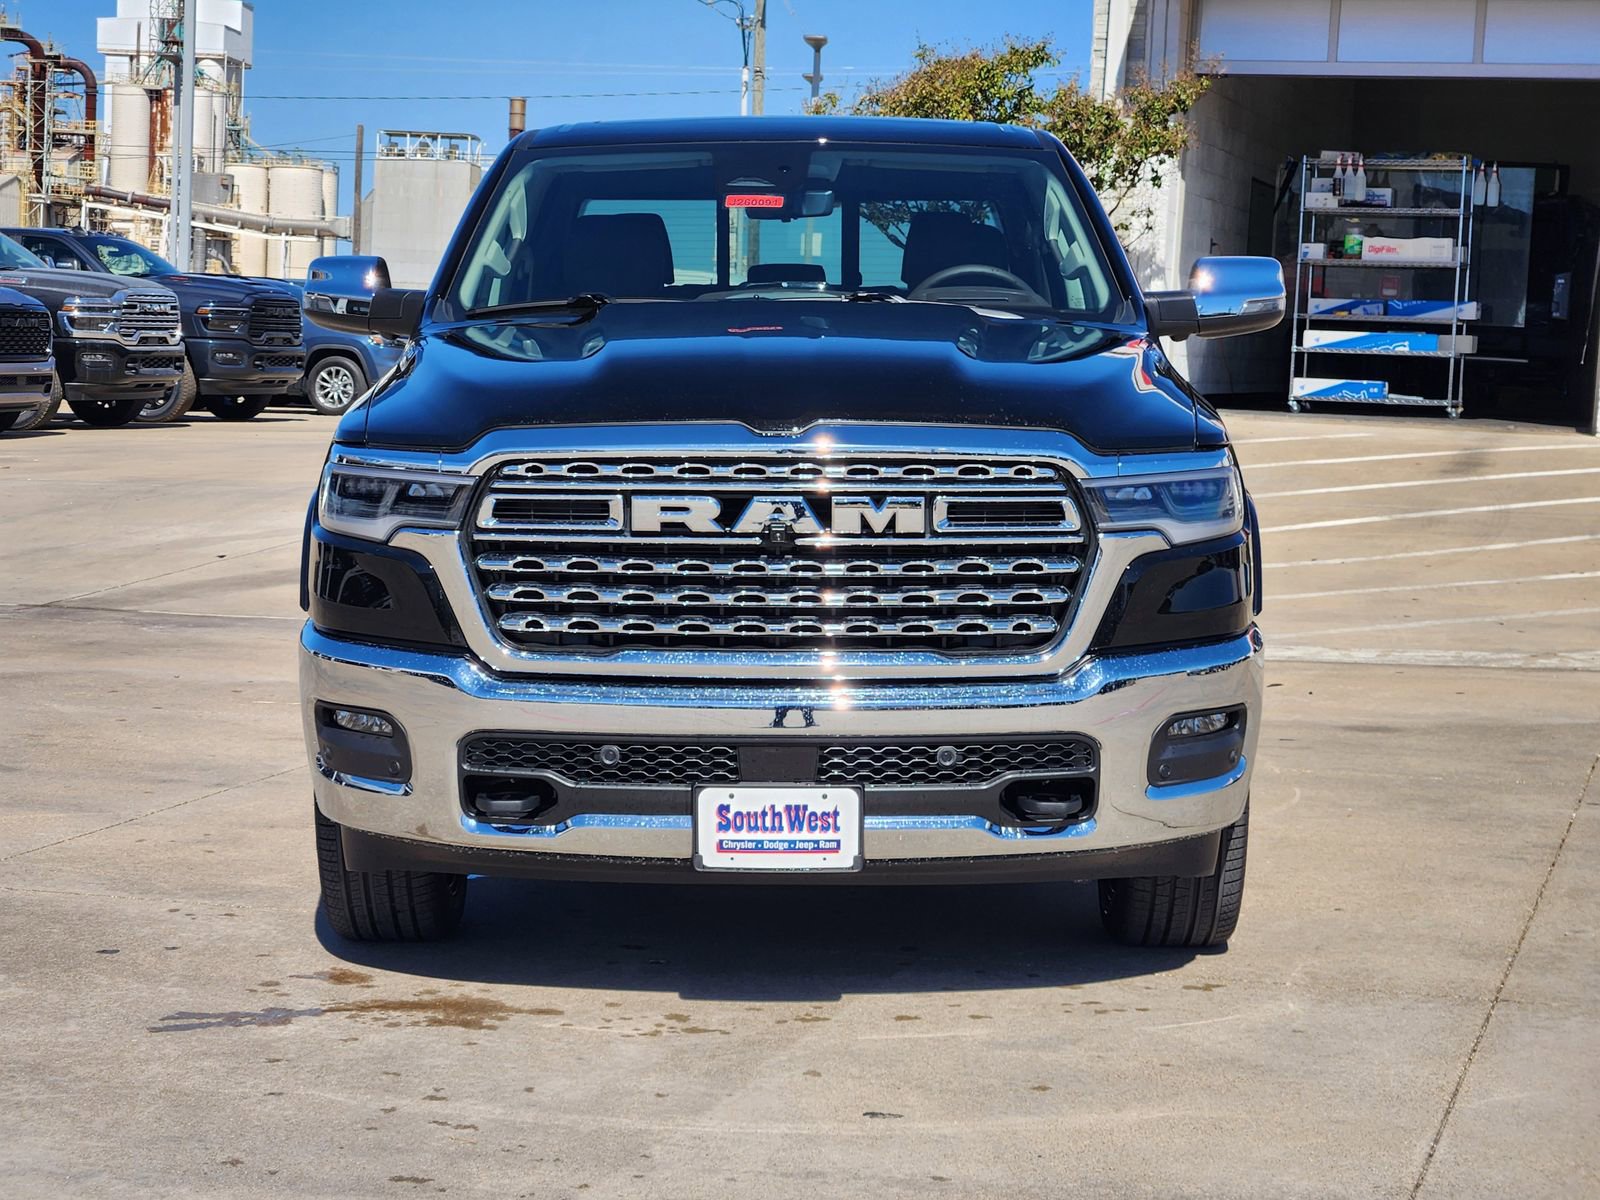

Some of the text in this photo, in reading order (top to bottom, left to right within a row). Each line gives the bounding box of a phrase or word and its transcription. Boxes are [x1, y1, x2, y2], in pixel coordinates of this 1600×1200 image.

[631, 495, 925, 534] RAM
[716, 803, 841, 833] SouthWest
[722, 840, 837, 849] Chrysler Dodge Jeep Ram
